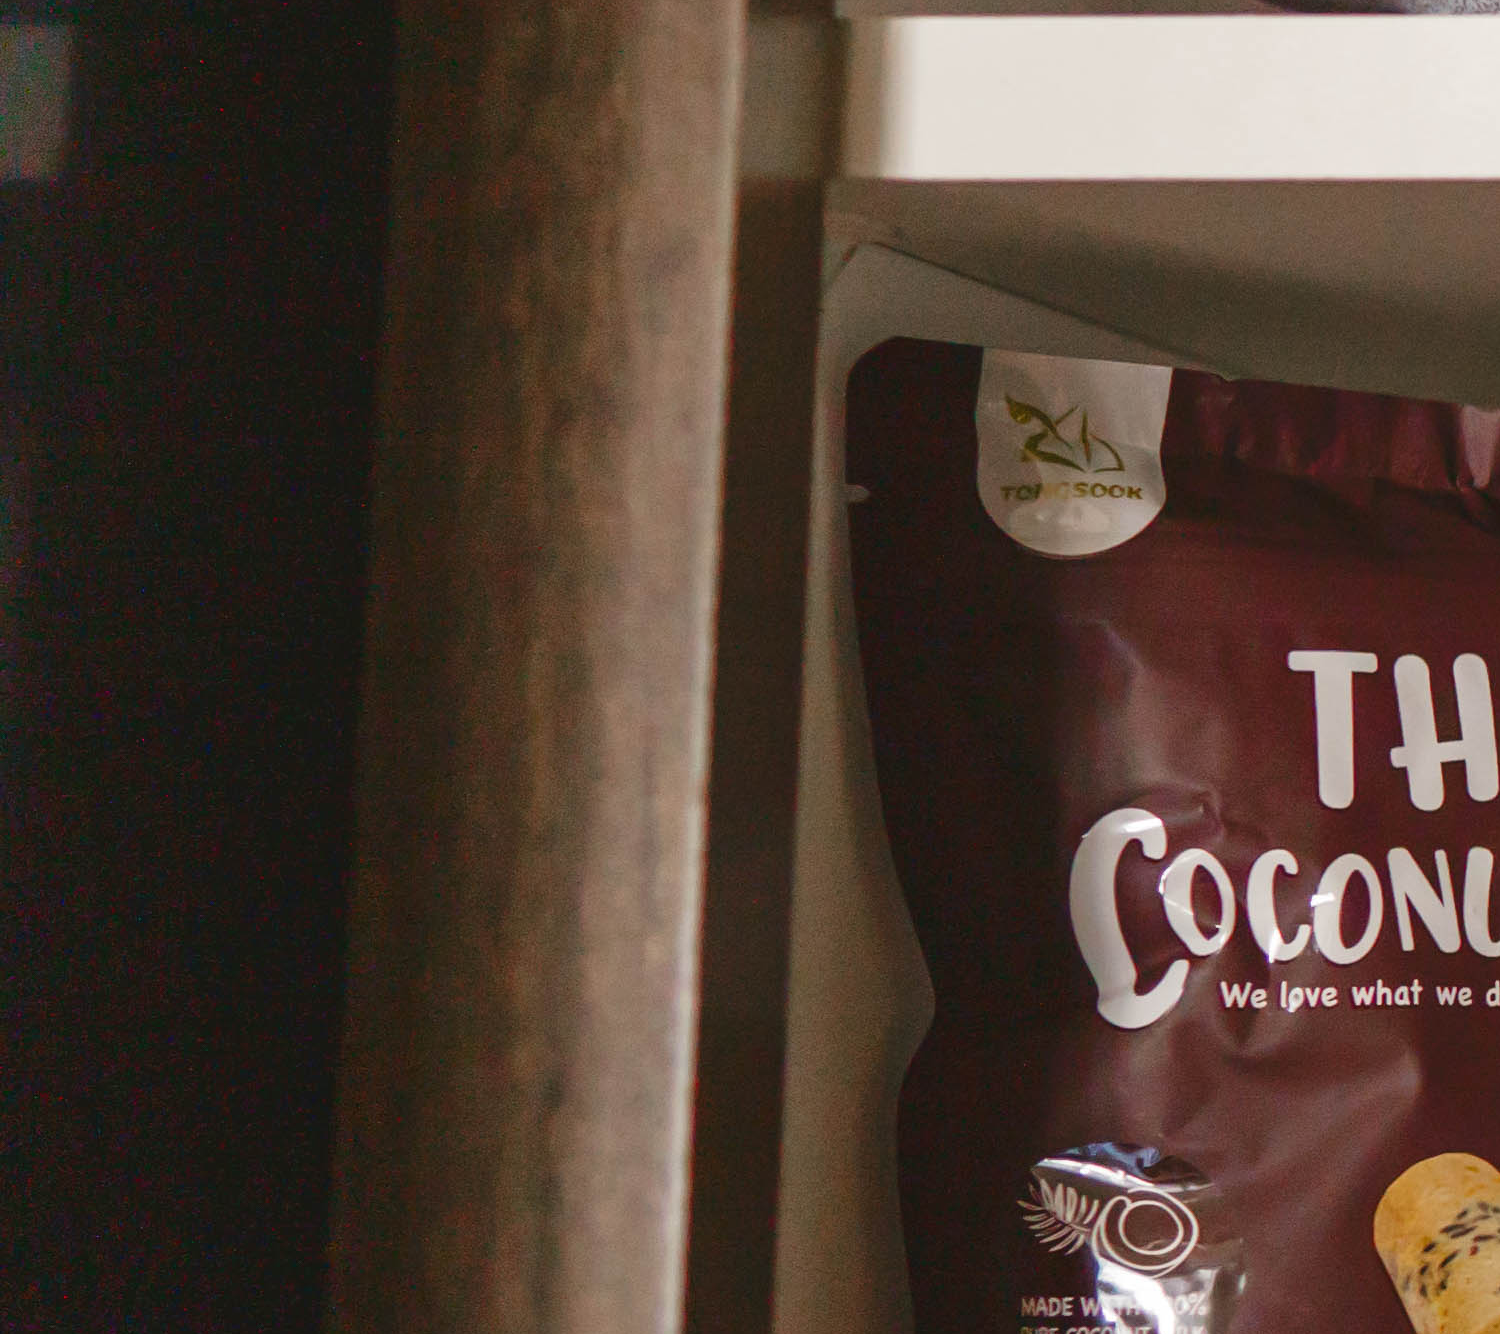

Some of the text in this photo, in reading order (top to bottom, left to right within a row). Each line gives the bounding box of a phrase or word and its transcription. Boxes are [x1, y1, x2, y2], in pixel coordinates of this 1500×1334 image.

[1001, 482, 1143, 502] TONGSOOK
[1220, 981, 1267, 1009] We
[1280, 980, 1338, 1013] love
[1351, 979, 1423, 1007] what
[1435, 985, 1472, 1006] we
[1021, 1297, 1140, 1317] MADE WTH
